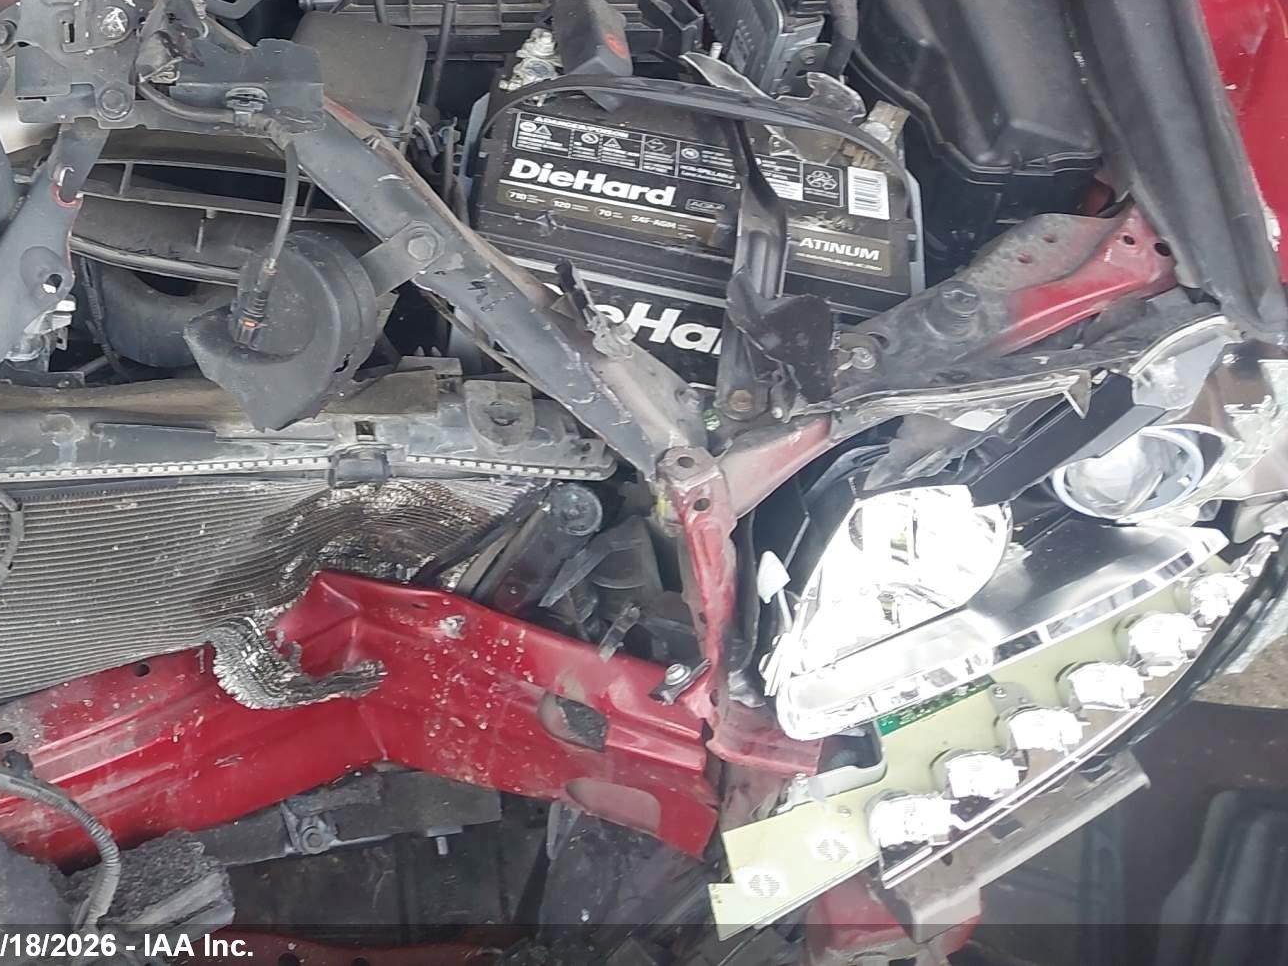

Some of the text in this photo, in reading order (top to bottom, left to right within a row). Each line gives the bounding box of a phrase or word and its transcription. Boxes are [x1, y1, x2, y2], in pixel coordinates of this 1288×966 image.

[509, 158, 677, 208] DieHard
[509, 191, 527, 202] 710
[552, 200, 572, 210] 120
[598, 208, 612, 218] 70
[799, 237, 880, 261] ATINUM
